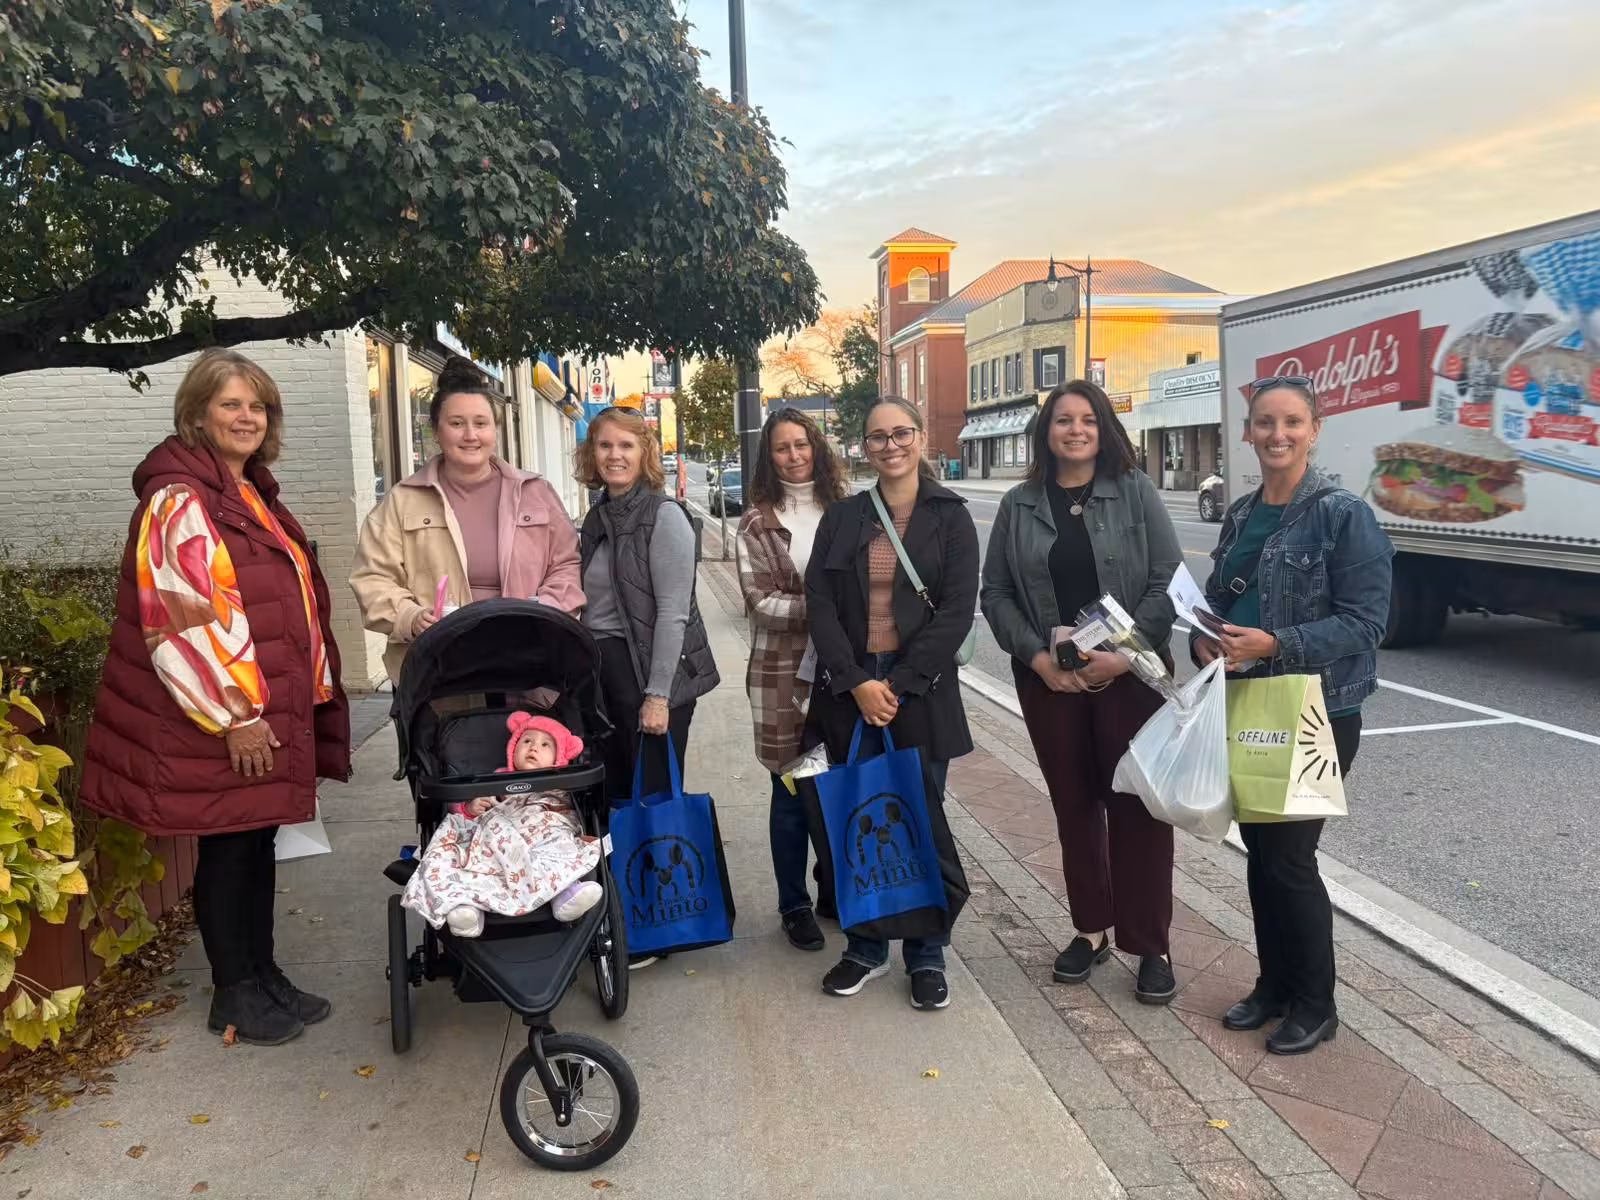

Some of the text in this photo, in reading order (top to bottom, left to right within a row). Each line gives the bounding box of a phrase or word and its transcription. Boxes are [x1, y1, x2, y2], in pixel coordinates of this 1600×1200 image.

[1186, 372, 1217, 385] DISCOUNT
[1237, 731, 1288, 744] OFFLINE
[855, 857, 929, 894] Minto
[631, 896, 708, 923] Minto
